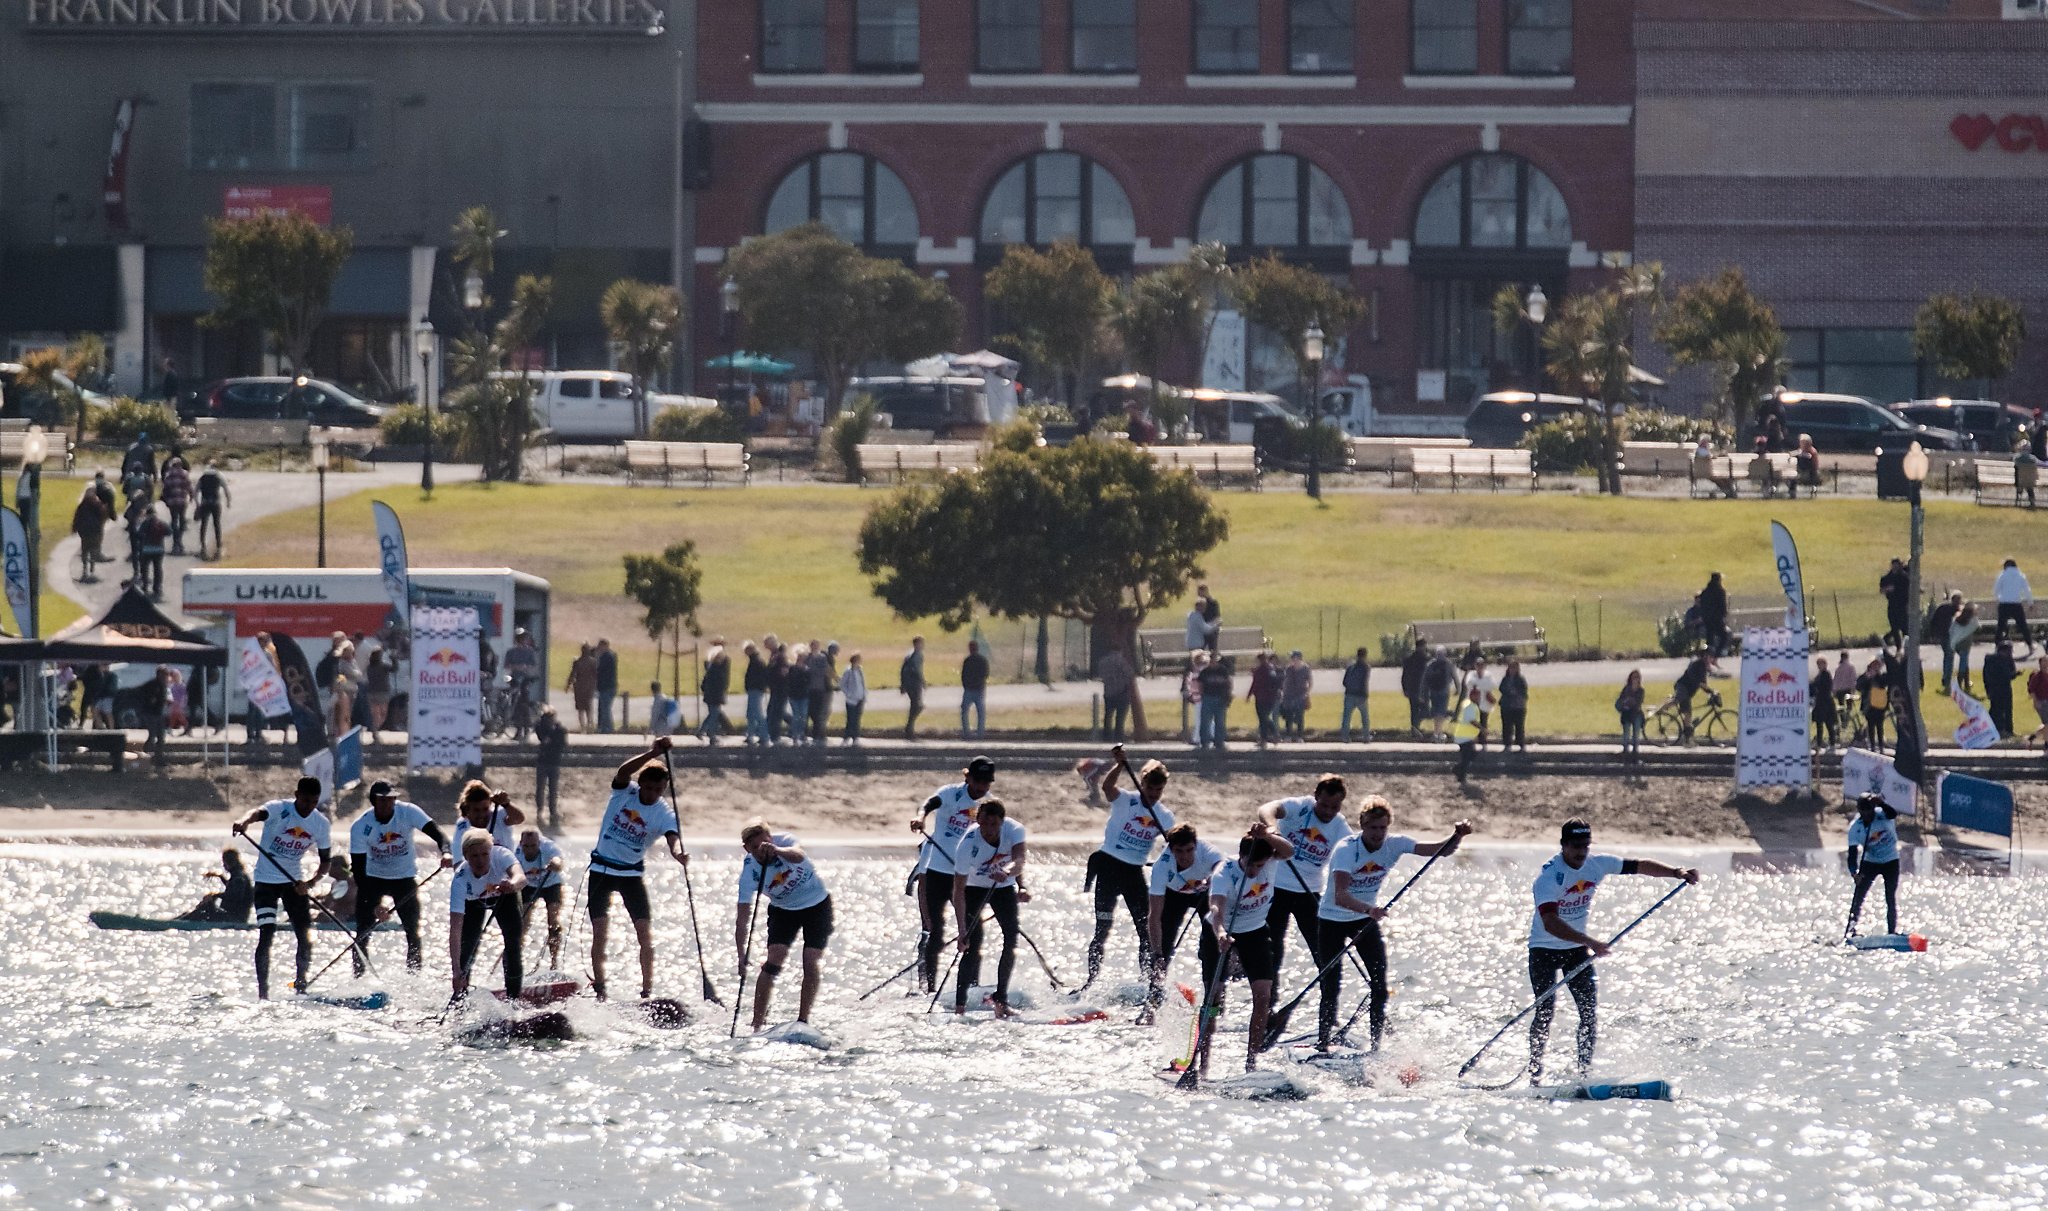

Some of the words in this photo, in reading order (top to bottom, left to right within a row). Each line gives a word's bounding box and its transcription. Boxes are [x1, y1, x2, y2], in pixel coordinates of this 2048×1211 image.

[420, 671, 446, 684] Red
[447, 671, 476, 684] Bull
[1747, 690, 1774, 704] Red
[1776, 690, 1805, 704] Bull
[1758, 769, 1789, 778] START
[949, 815, 970, 829] Red
[1123, 822, 1145, 838] Red
[273, 836, 295, 849] Red
[1307, 845, 1331, 857] Bull
[1558, 896, 1581, 907] Red
